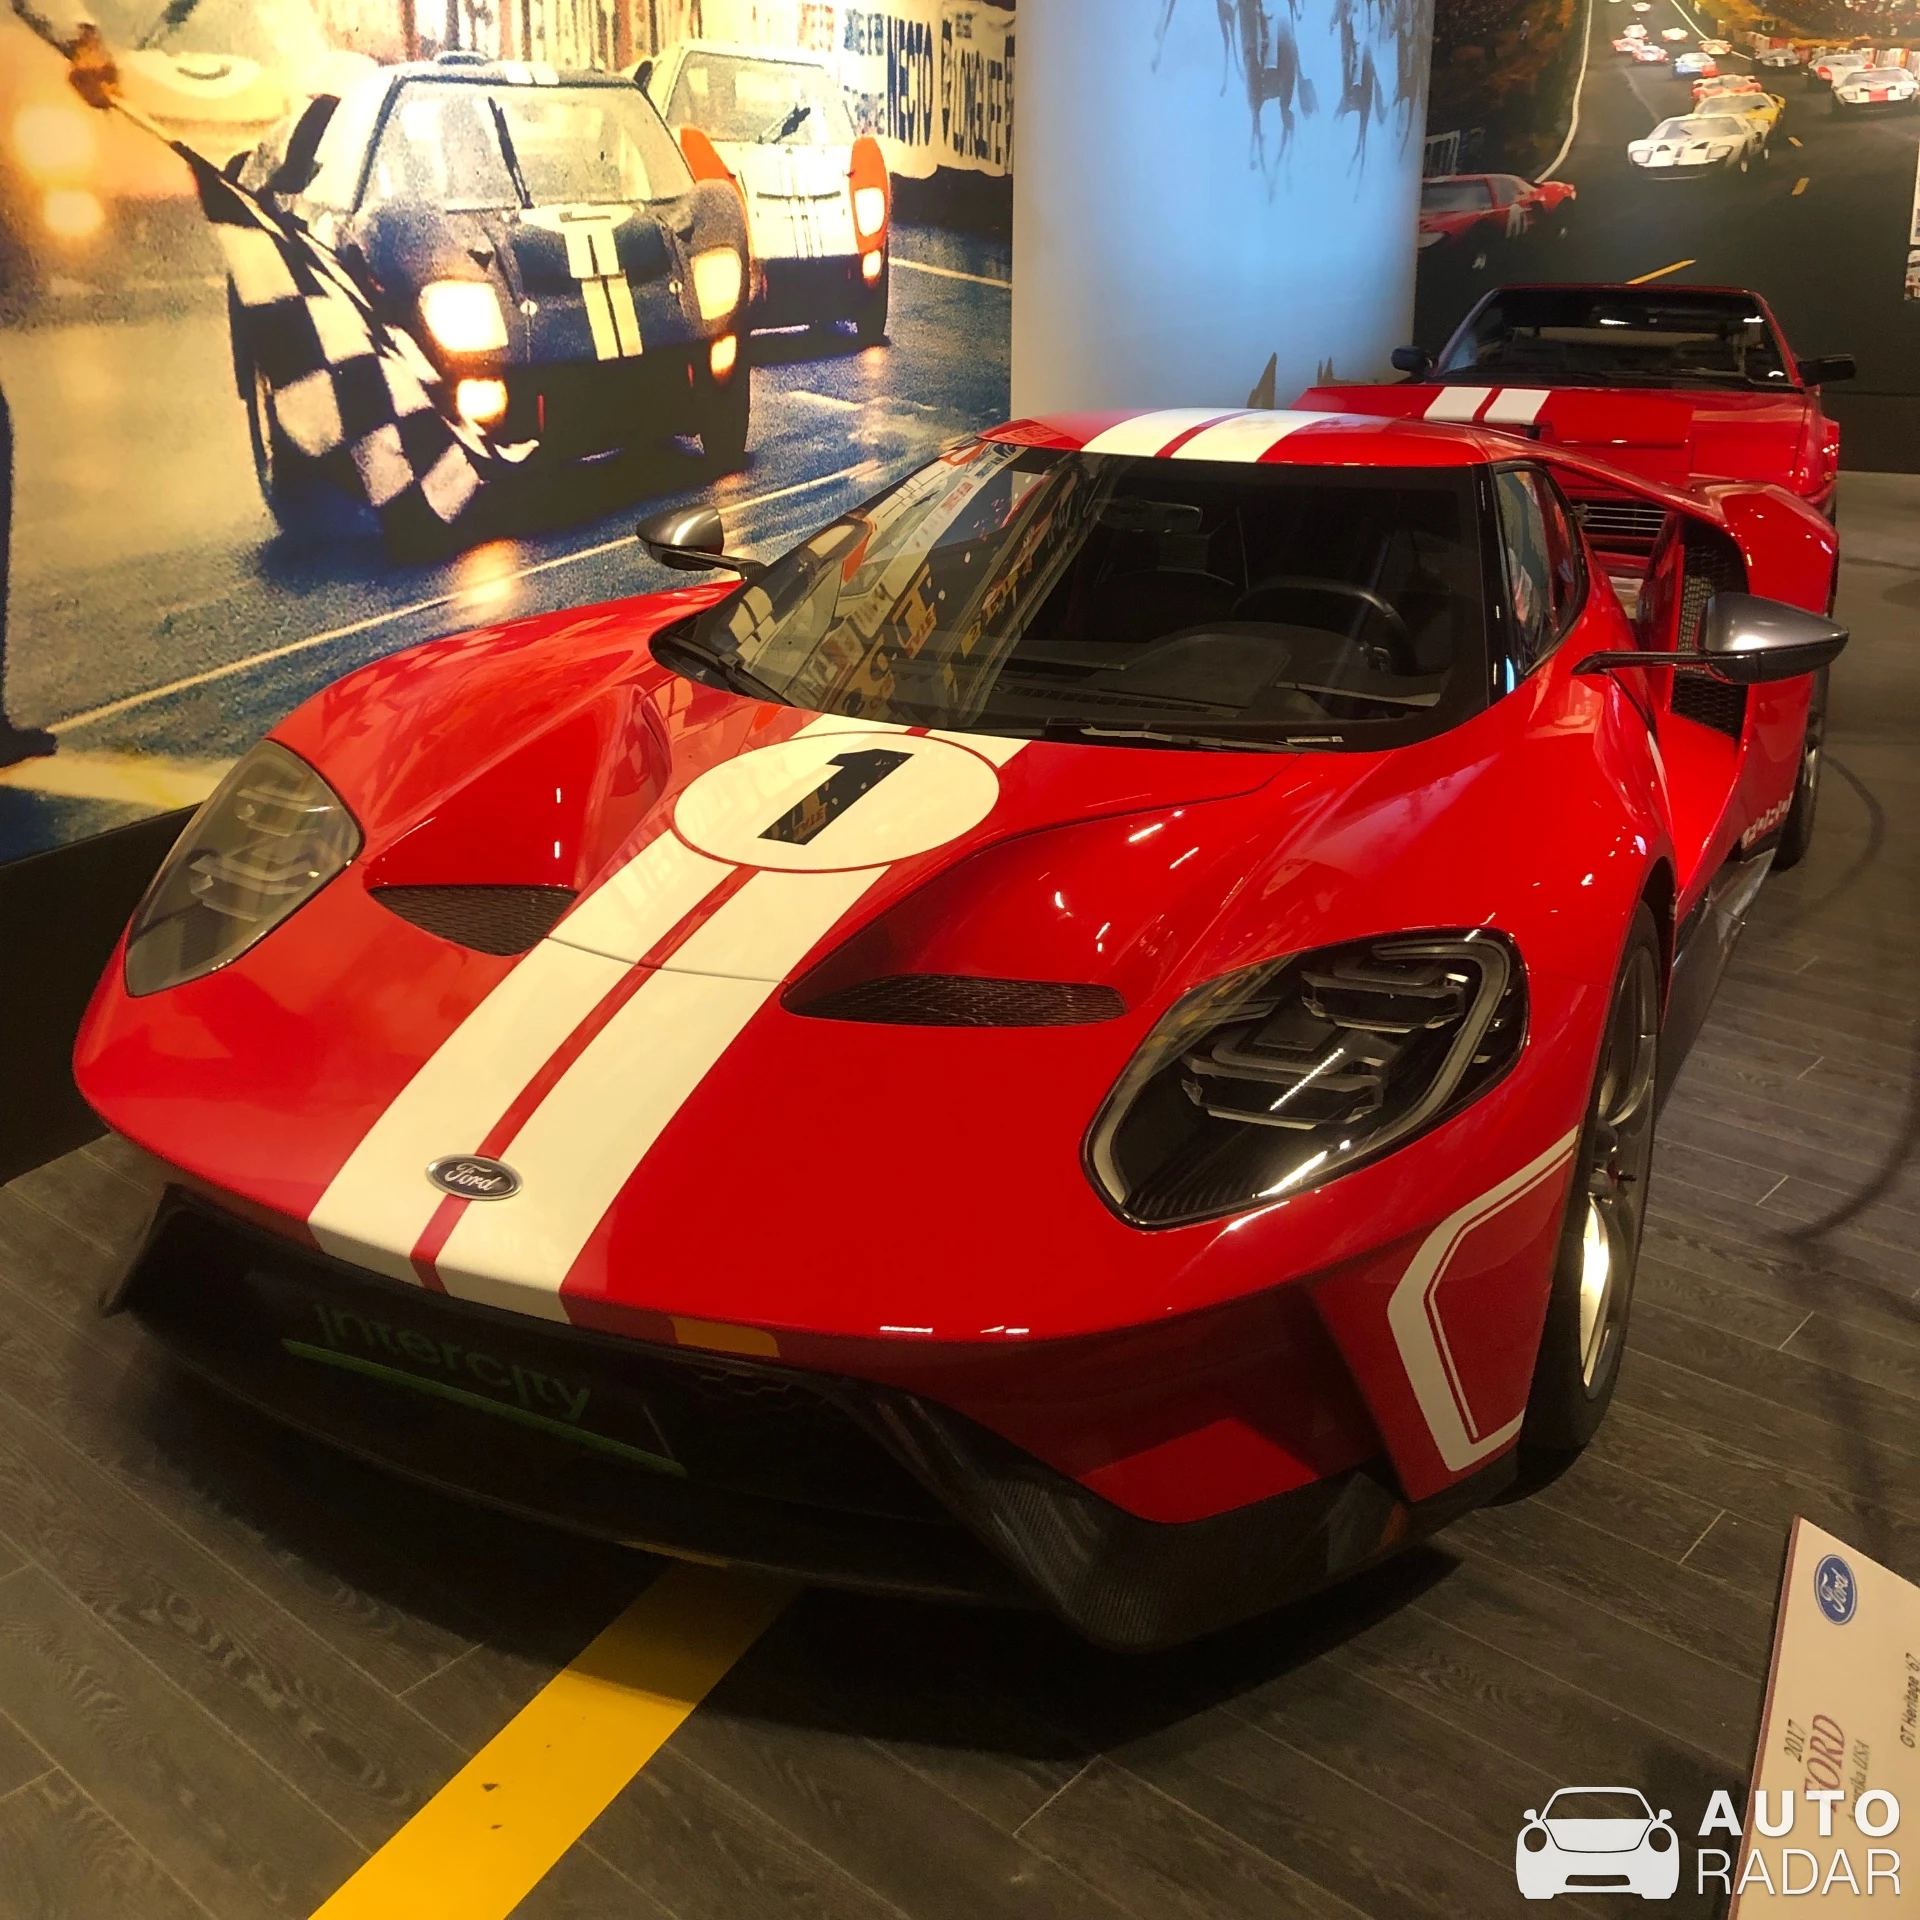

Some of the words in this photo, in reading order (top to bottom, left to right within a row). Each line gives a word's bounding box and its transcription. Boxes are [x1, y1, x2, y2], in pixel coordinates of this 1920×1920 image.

[757, 748, 915, 845] 1
[444, 1162, 502, 1191] Ford
[1820, 1567, 1849, 1613] Ford
[1901, 1675, 1920, 1728] Heritage
[1784, 1718, 1806, 1763] 2017
[1900, 1725, 1916, 1748] GT
[1847, 1771, 1867, 1824] erika
